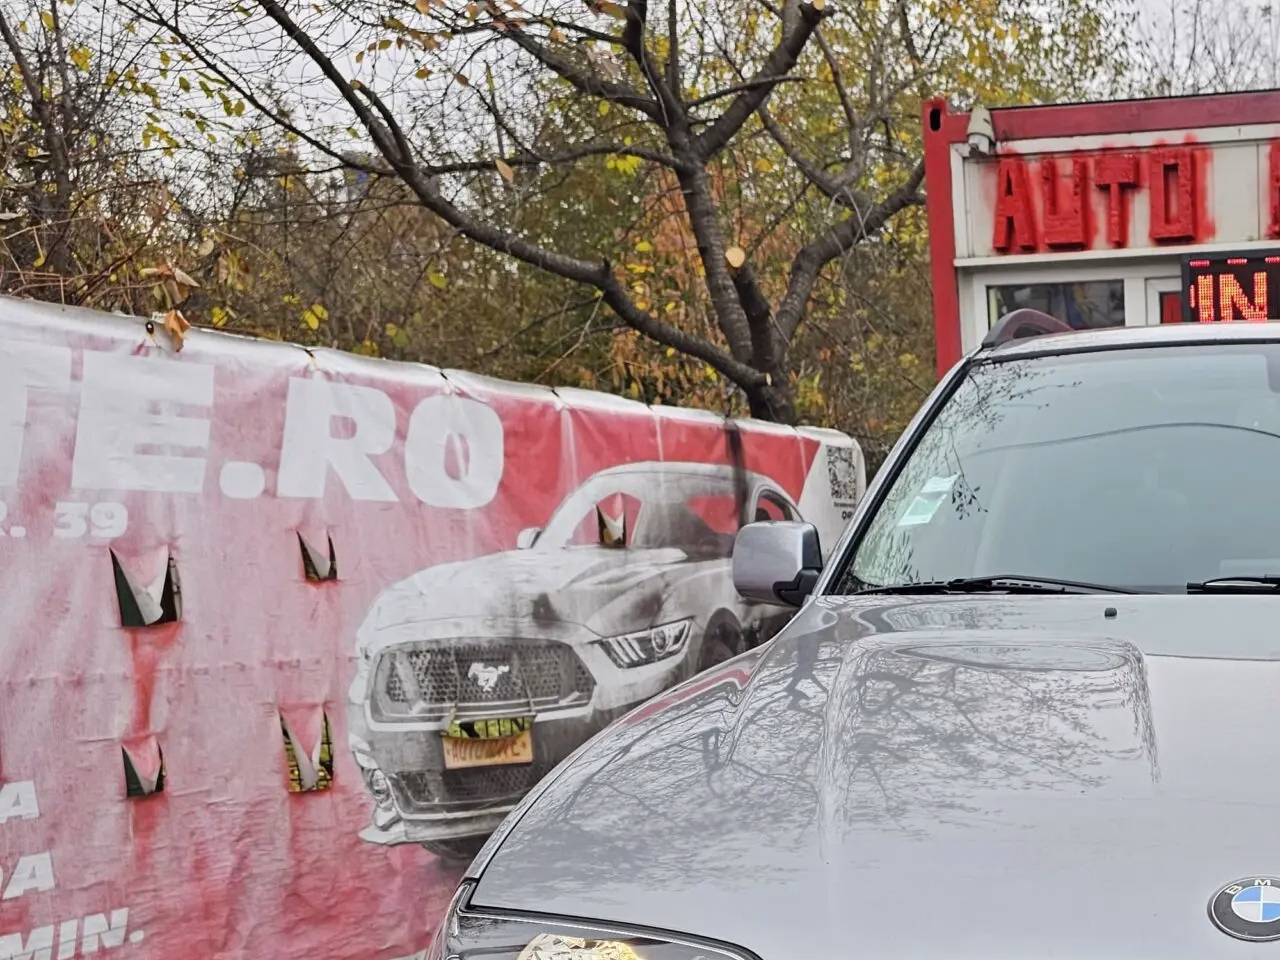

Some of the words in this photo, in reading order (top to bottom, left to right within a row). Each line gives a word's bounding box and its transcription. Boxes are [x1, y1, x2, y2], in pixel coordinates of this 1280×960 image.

[993, 143, 1199, 252] AUTO
[1197, 271, 1268, 322] IN
[54, 502, 129, 538] 39
